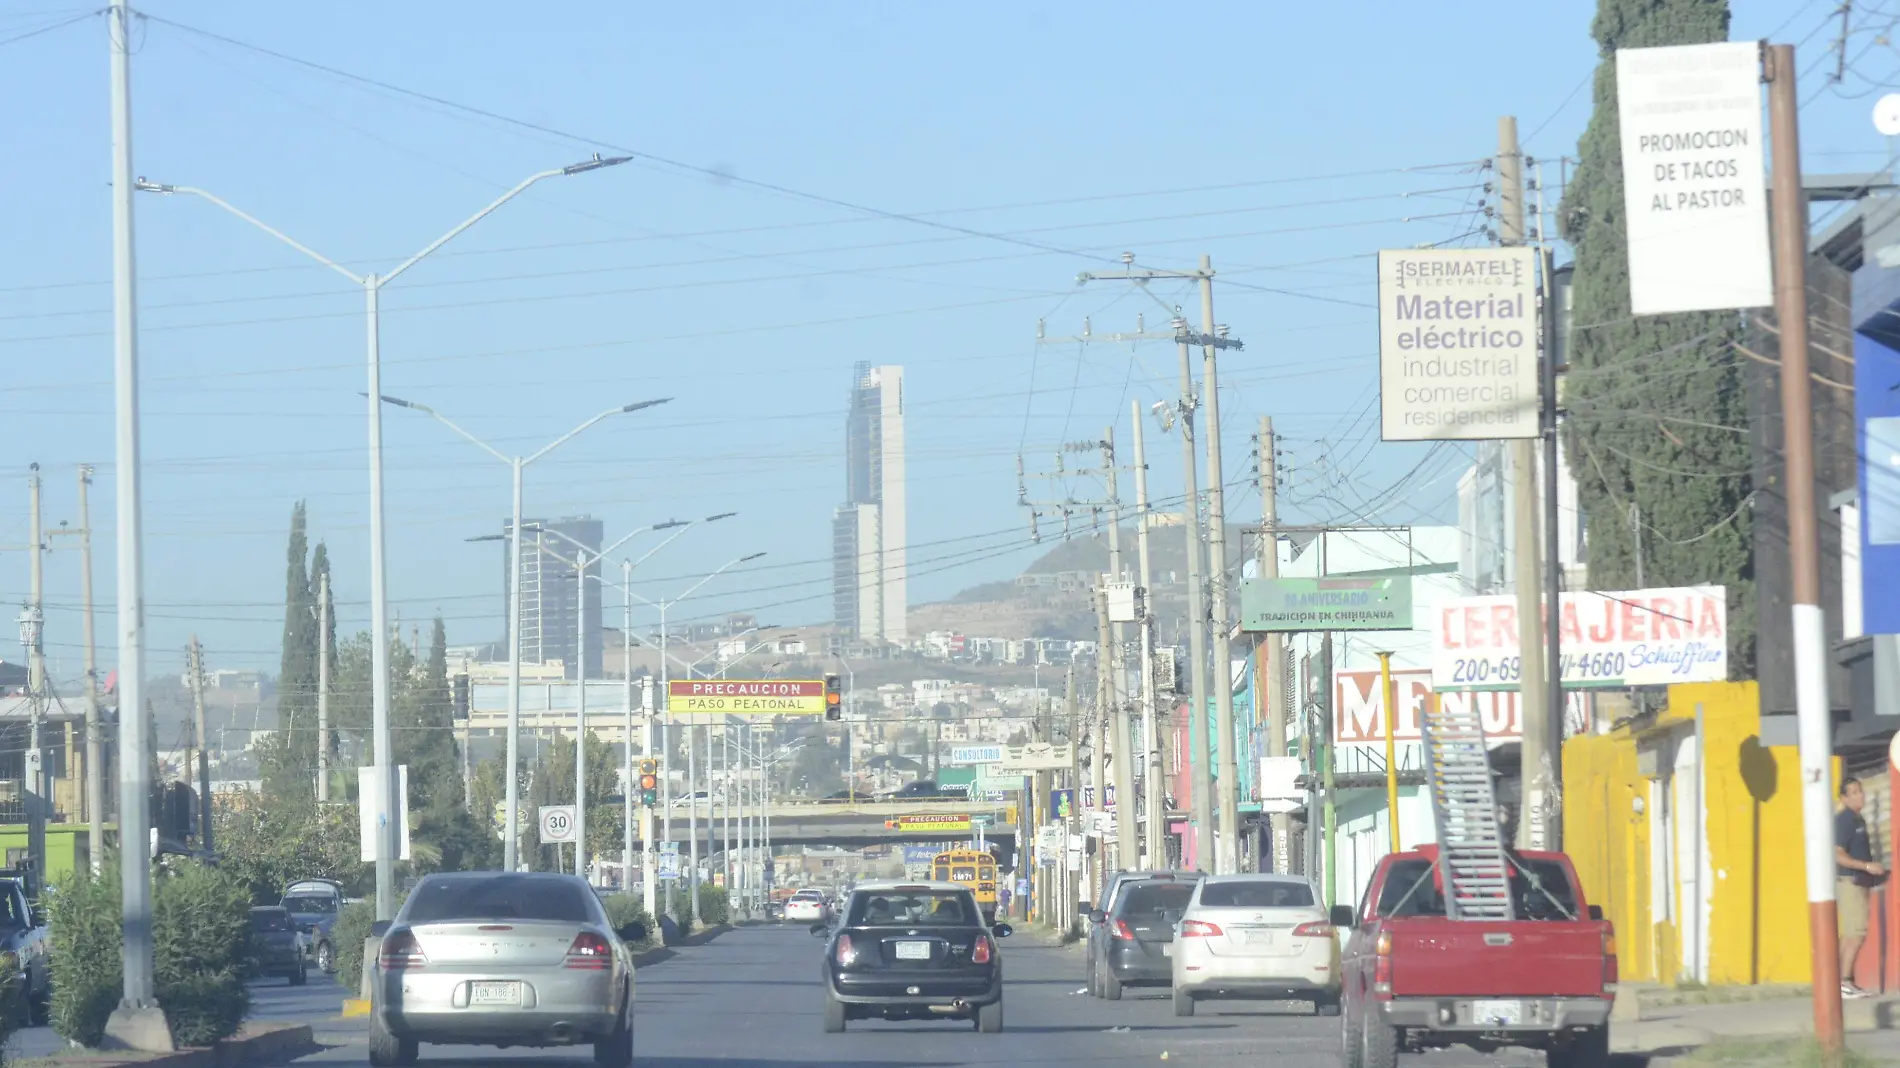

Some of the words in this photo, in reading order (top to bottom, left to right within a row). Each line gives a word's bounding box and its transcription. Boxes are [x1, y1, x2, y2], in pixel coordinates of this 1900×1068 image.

[1640, 129, 1748, 152] PROMOCION
[1655, 163, 1676, 181] DE
[1681, 159, 1738, 180] TACOS
[1651, 193, 1672, 212] AL
[1677, 188, 1745, 211] PASTOR
[1406, 260, 1512, 276] SERMATEL
[1396, 293, 1523, 320] Material
[1397, 325, 1523, 349] eléctrico
[1403, 355, 1519, 377] industrial
[1404, 382, 1519, 403] comercial
[1404, 408, 1520, 426] residencial
[1301, 590, 1369, 607] ANIVERSARIO
[1260, 612, 1316, 622] TRADICION
[1319, 612, 1332, 621] EN
[1442, 597, 1722, 650] CERAJERIA
[693, 683, 801, 695] PRECAUCION
[688, 699, 725, 709] PASO
[734, 699, 804, 709] PEATONAL
[953, 748, 1000, 760] CONSULTORIO
[550, 816, 567, 829] 30
